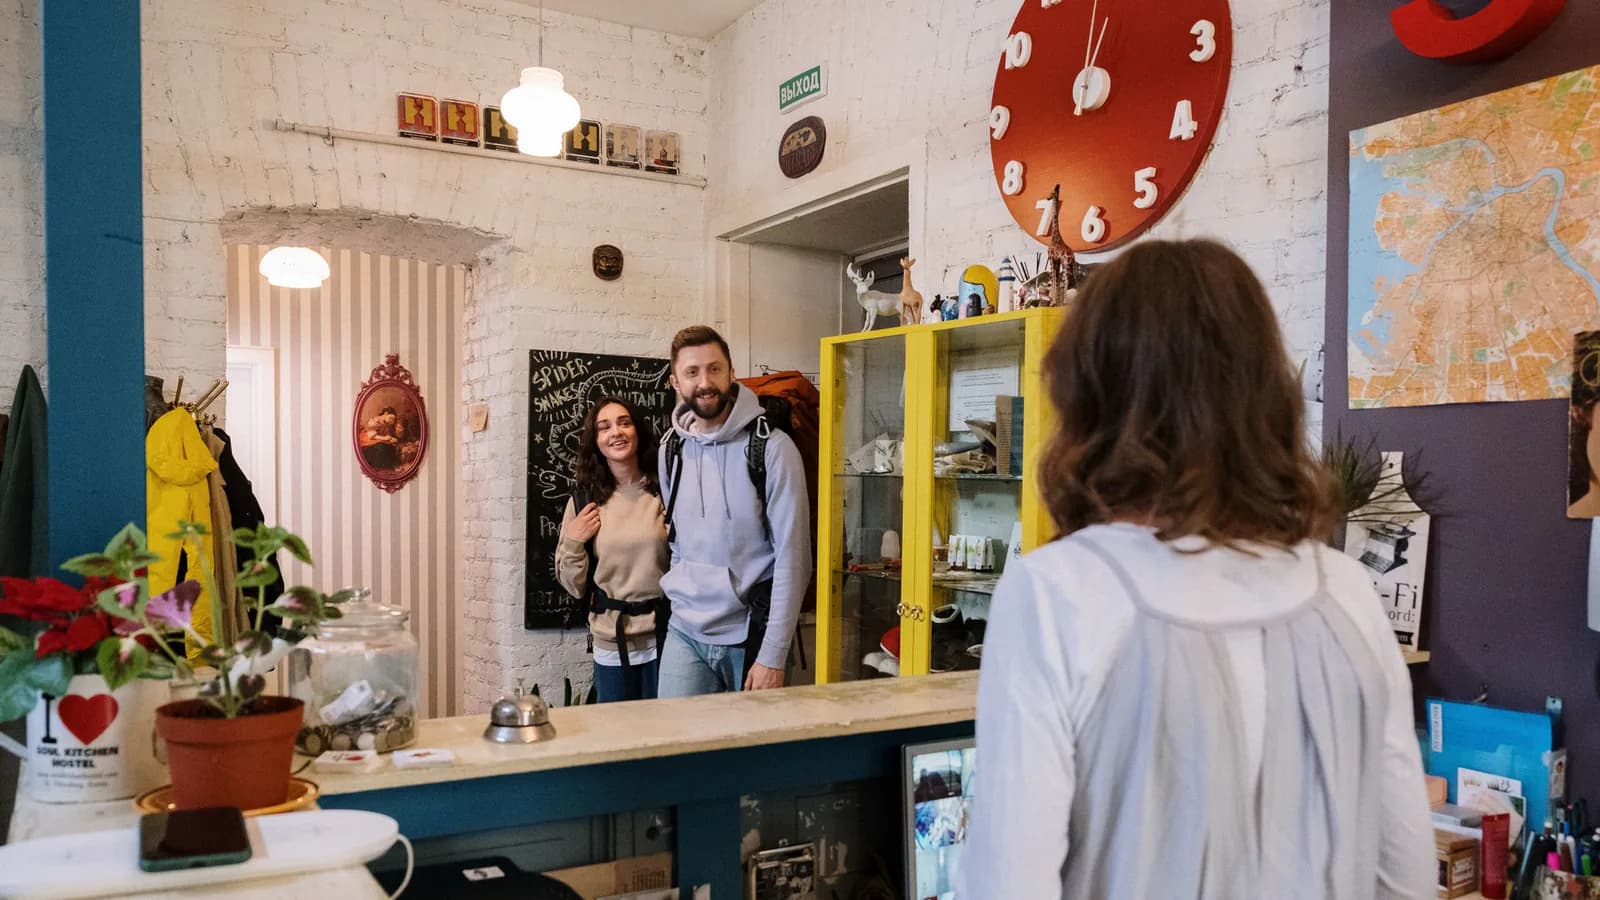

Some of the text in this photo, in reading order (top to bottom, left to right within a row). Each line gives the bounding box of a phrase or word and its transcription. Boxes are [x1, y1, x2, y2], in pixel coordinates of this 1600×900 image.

[1001, 31, 1033, 71] 10
[1189, 19, 1216, 63] 3
[781, 71, 820, 104] ВЫХОД
[989, 105, 1010, 140] 9
[1168, 99, 1198, 141] 4
[1002, 160, 1024, 196] 8
[1133, 166, 1158, 208] 5
[1035, 198, 1053, 236] 7
[1081, 205, 1106, 242] 6
[1385, 609, 1415, 623] ord:
[42, 692, 57, 744] I
[52, 759, 95, 768] HOSTEL
[64, 746, 118, 756] KITCHEN
